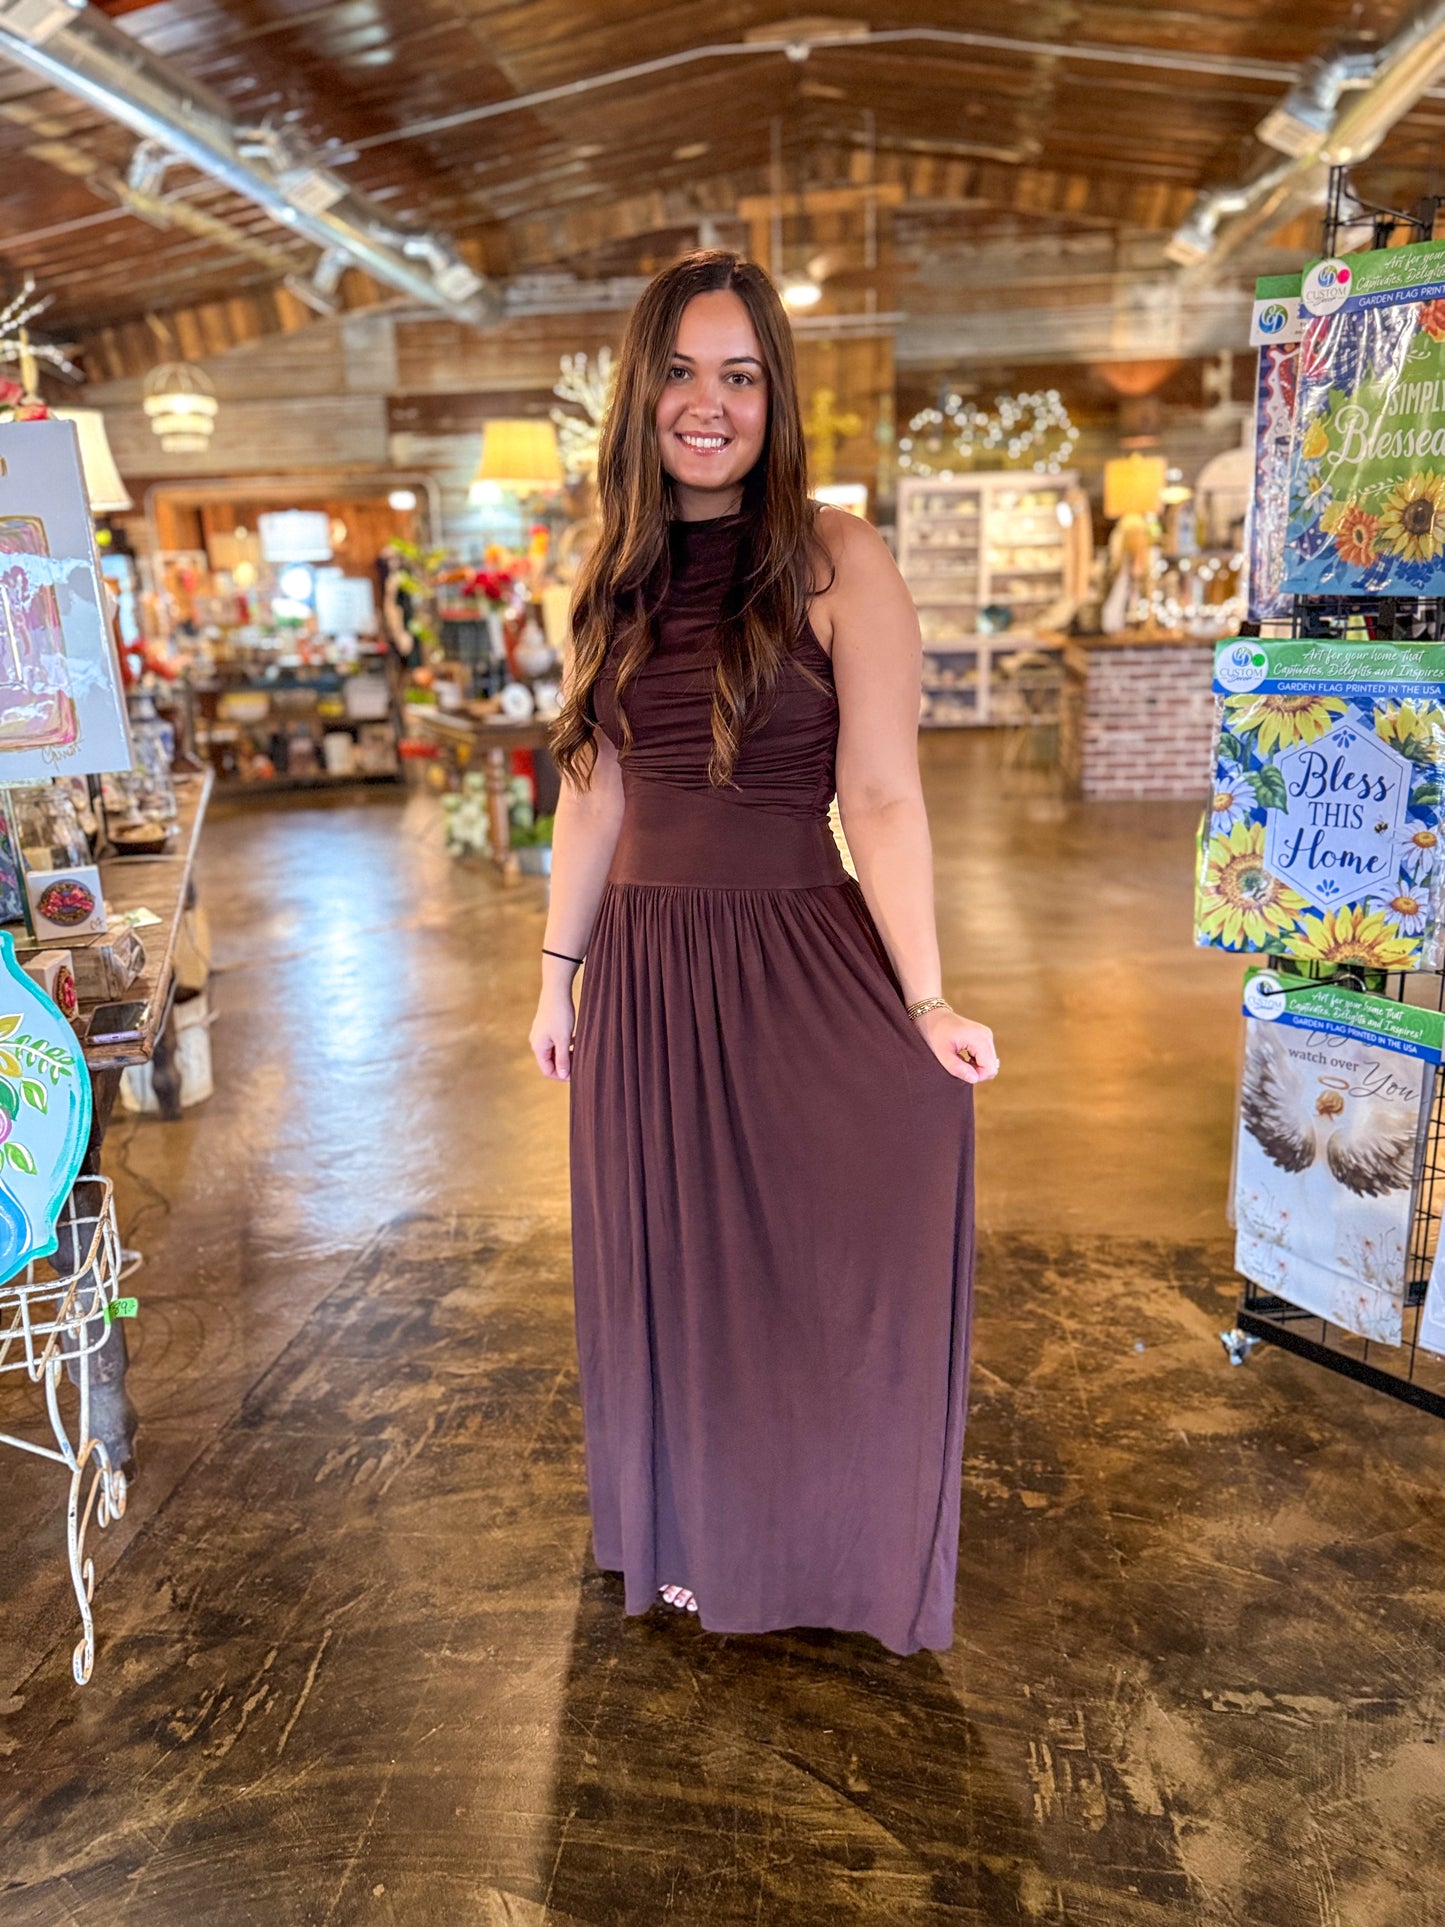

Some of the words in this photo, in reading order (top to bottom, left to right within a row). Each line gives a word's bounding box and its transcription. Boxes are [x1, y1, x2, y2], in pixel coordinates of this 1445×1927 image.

[1385, 255, 1406, 269] Art
[1404, 252, 1421, 271] for
[1306, 286, 1347, 300] CUSTOM
[1358, 293, 1394, 307] GARDEN
[1395, 289, 1418, 303] FLAG
[1388, 380, 1445, 416] SIMPL
[1302, 647, 1324, 660] Art
[1324, 648, 1342, 665] for
[1341, 652, 1369, 667] your
[1369, 647, 1398, 661] home
[1400, 647, 1426, 664] that
[1219, 667, 1263, 678] CUSTOM
[1327, 662, 1372, 682] Delights
[1374, 664, 1397, 677] and
[1277, 682, 1316, 692] GARDEN
[1318, 682, 1343, 693] FLAG
[1345, 684, 1386, 694] PRINTED
[1388, 685, 1398, 694] IN
[1401, 685, 1420, 694] THE
[1422, 686, 1442, 695] USA
[1288, 751, 1396, 802] Bless
[1308, 801, 1364, 830] THIS
[1278, 827, 1388, 874] Home
[1312, 991, 1329, 1002] Art
[1329, 993, 1344, 1008] for
[1292, 1016, 1324, 1029] GARDEN
[1325, 1023, 1347, 1034] FLAG
[1347, 1027, 1377, 1042] PRINTED
[1378, 1036, 1386, 1044] IN
[1387, 1038, 1402, 1050] THE
[1402, 1043, 1418, 1054] USA
[1367, 1016, 1384, 1029] and
[1383, 1019, 1424, 1040] Inspires!
[1288, 1047, 1327, 1065] watch
[1330, 1058, 1360, 1072] over
[1348, 1060, 1420, 1101] You
